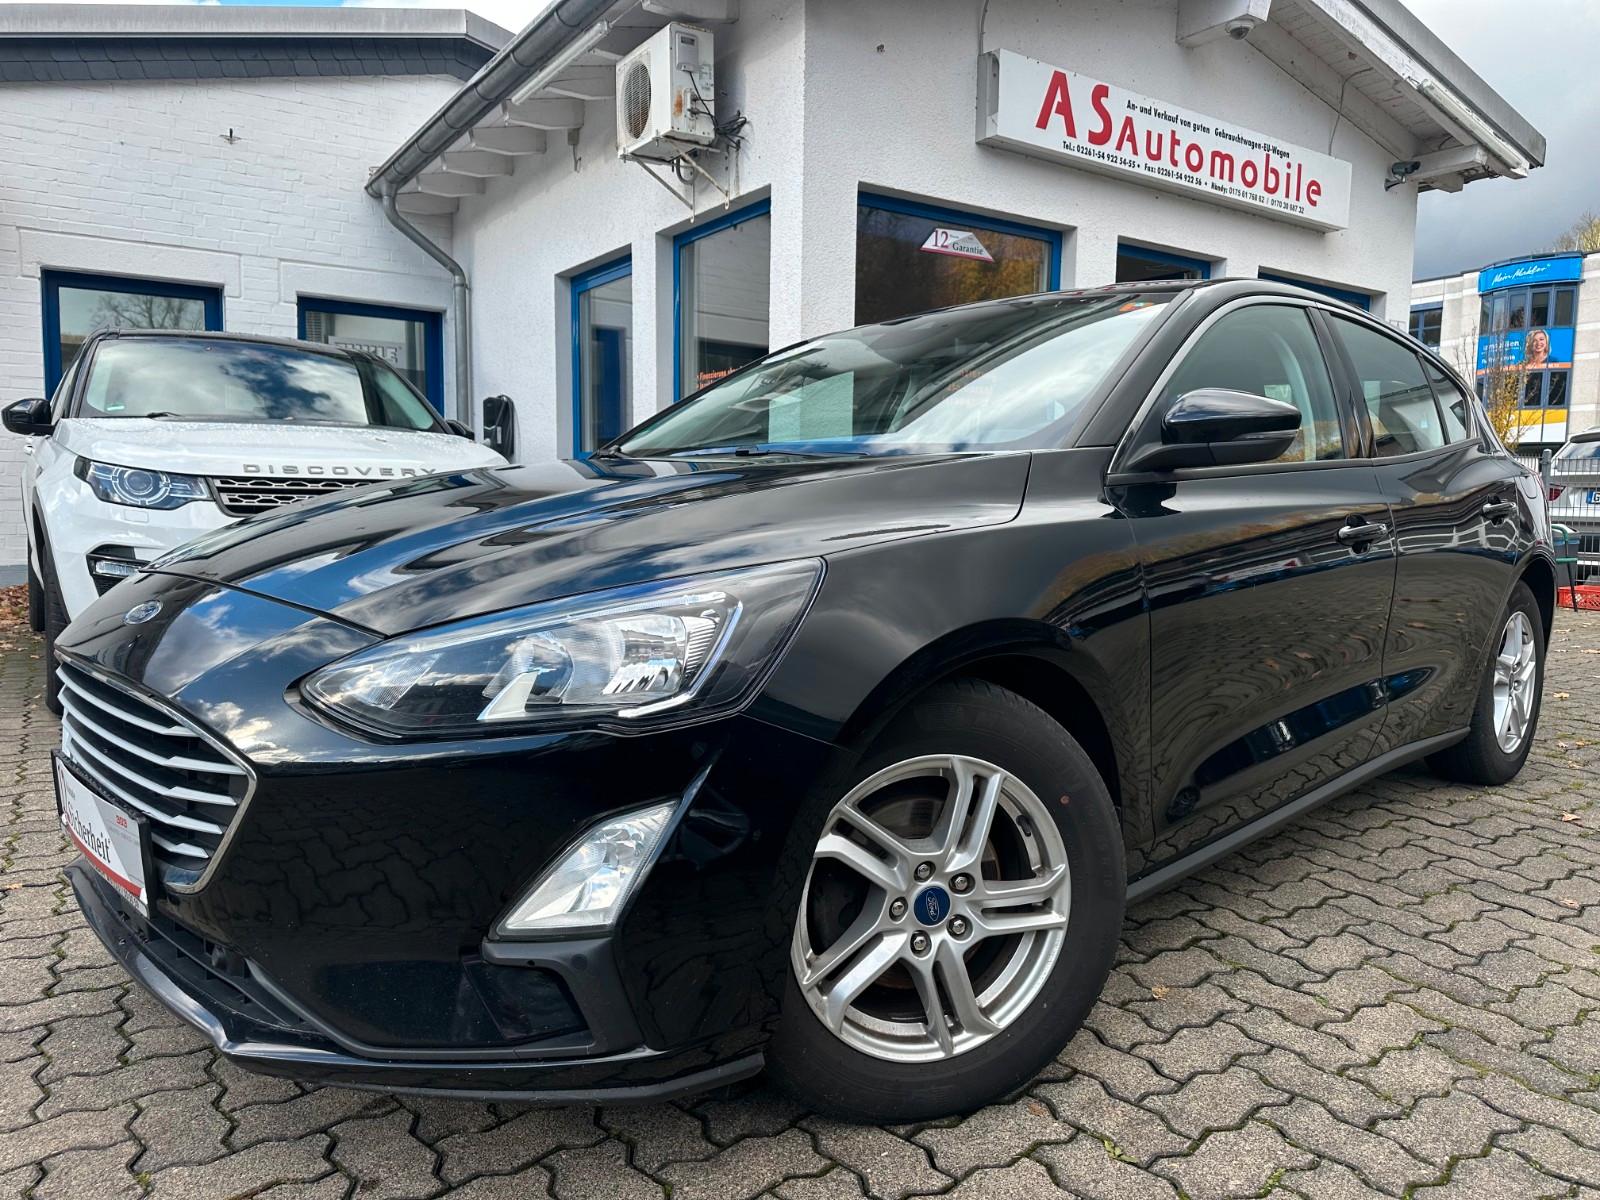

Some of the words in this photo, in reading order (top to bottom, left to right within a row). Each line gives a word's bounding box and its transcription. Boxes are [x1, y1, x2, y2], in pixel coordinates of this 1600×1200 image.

[1126, 99, 1138, 111] An-
[1139, 105, 1152, 116] und
[1153, 107, 1179, 124] Verkauf
[1179, 118, 1191, 128] von
[1192, 122, 1210, 134] guten
[1062, 140, 1075, 152] Tel.:
[1076, 144, 1105, 160] 02261-54
[1106, 153, 1118, 164] 922
[1119, 156, 1136, 169] 54-55
[1144, 162, 1156, 174] Fax:
[1157, 166, 1183, 180] 02261-54
[1183, 174, 1195, 184] 922
[1195, 177, 1202, 186] 56
[1115, 115, 1321, 207] Automobile
[933, 230, 949, 249] 12
[952, 242, 984, 255] Garantie
